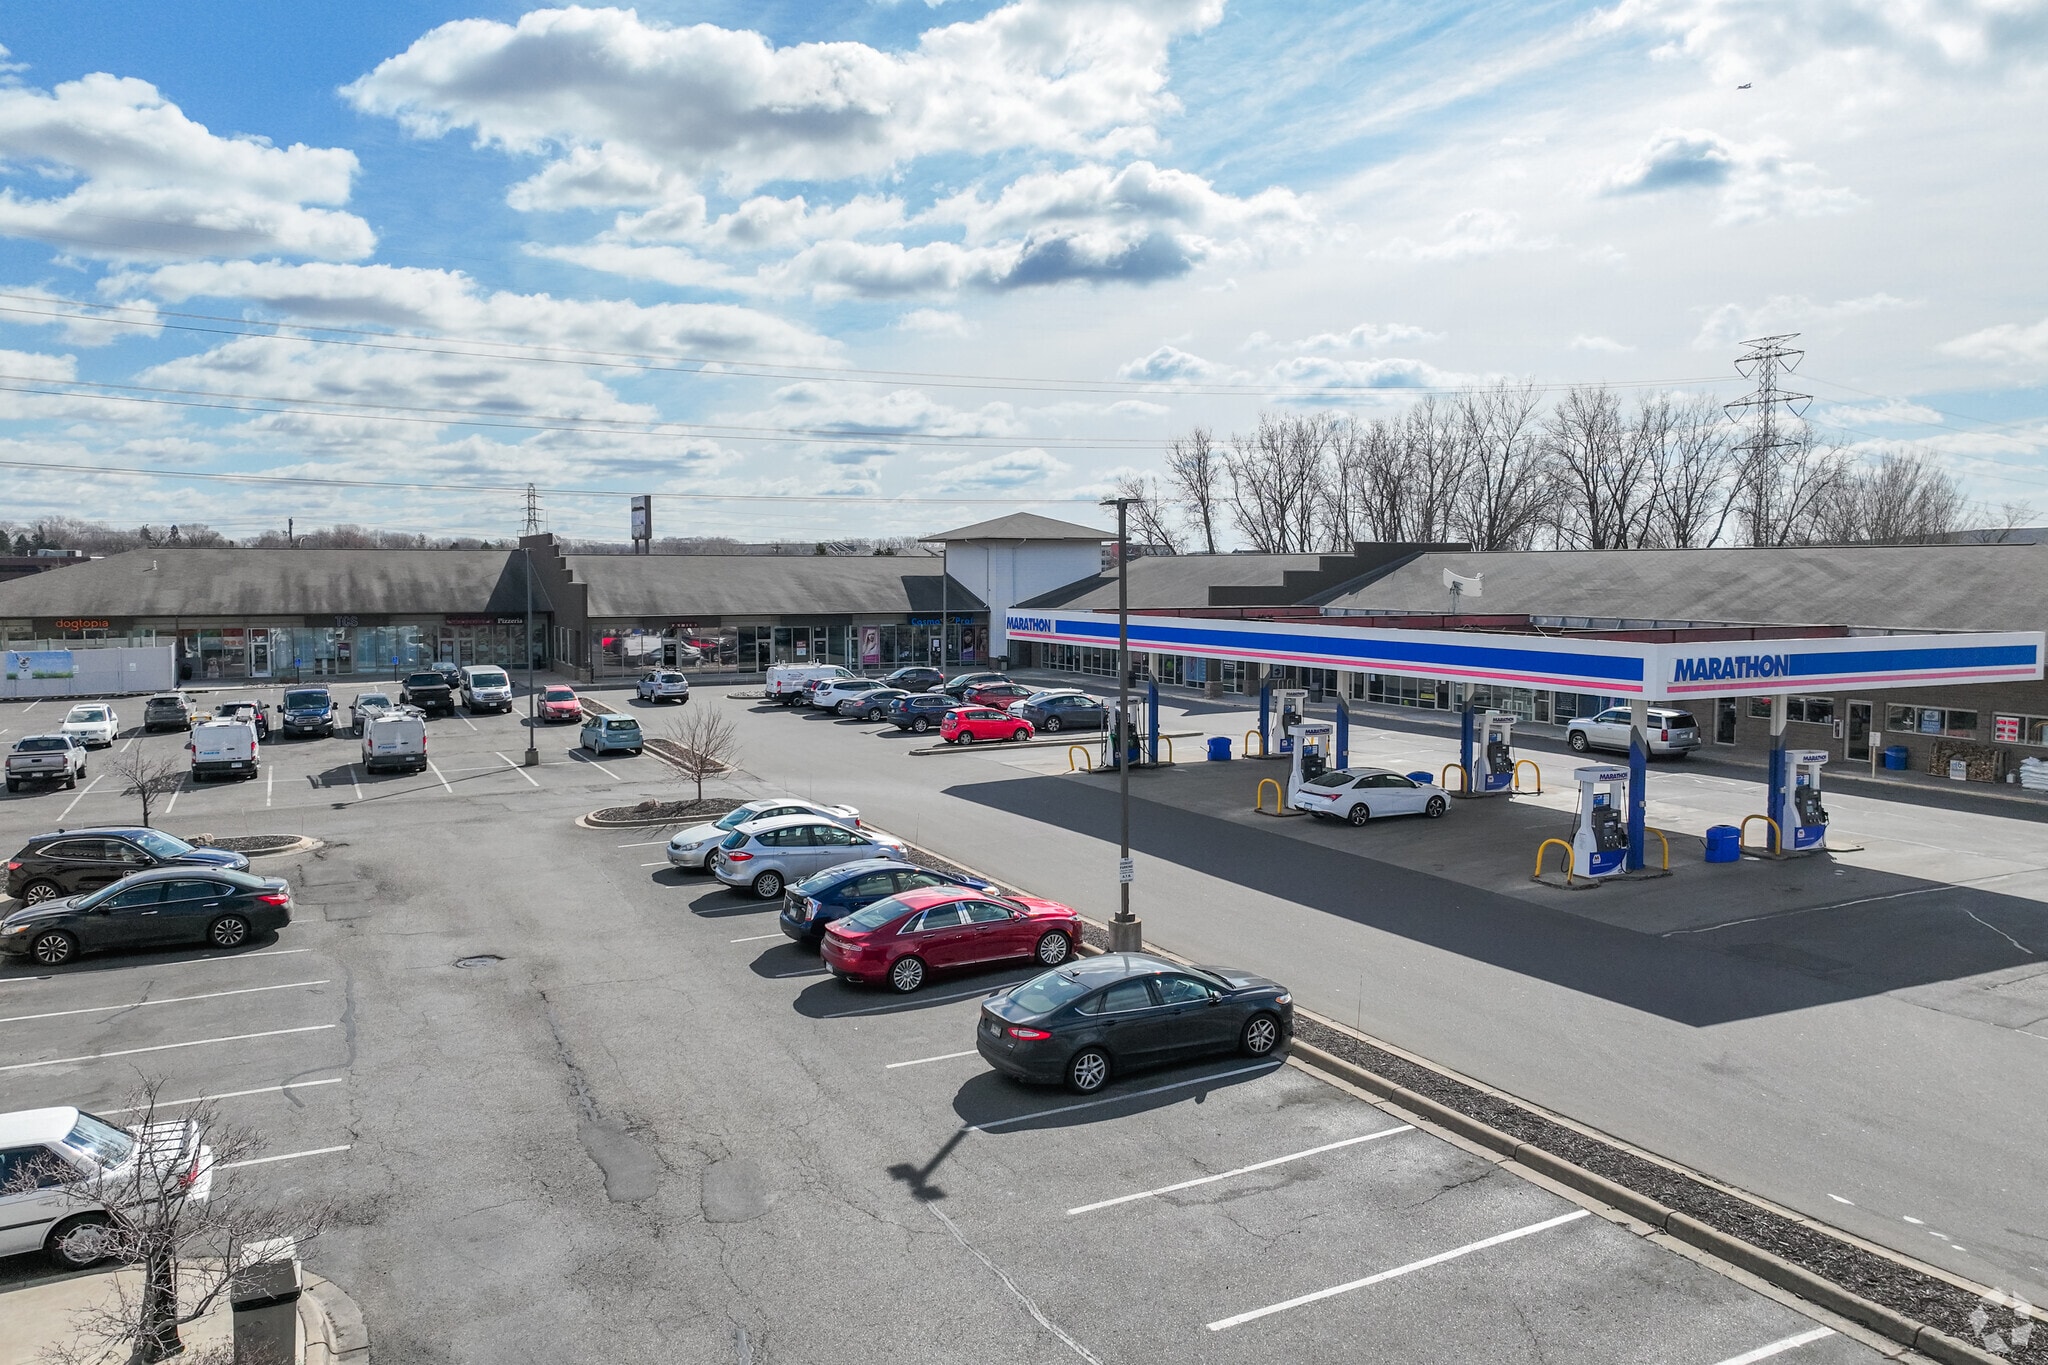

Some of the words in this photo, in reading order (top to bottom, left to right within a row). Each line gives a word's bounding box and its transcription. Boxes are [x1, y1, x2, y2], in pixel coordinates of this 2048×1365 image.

[55, 619, 109, 631] dogtopia
[911, 617, 940, 625] Cosmo
[1006, 616, 1051, 632] MARATHON
[1673, 654, 1789, 682] MARATHON
[1600, 772, 1628, 780] MARATHON
